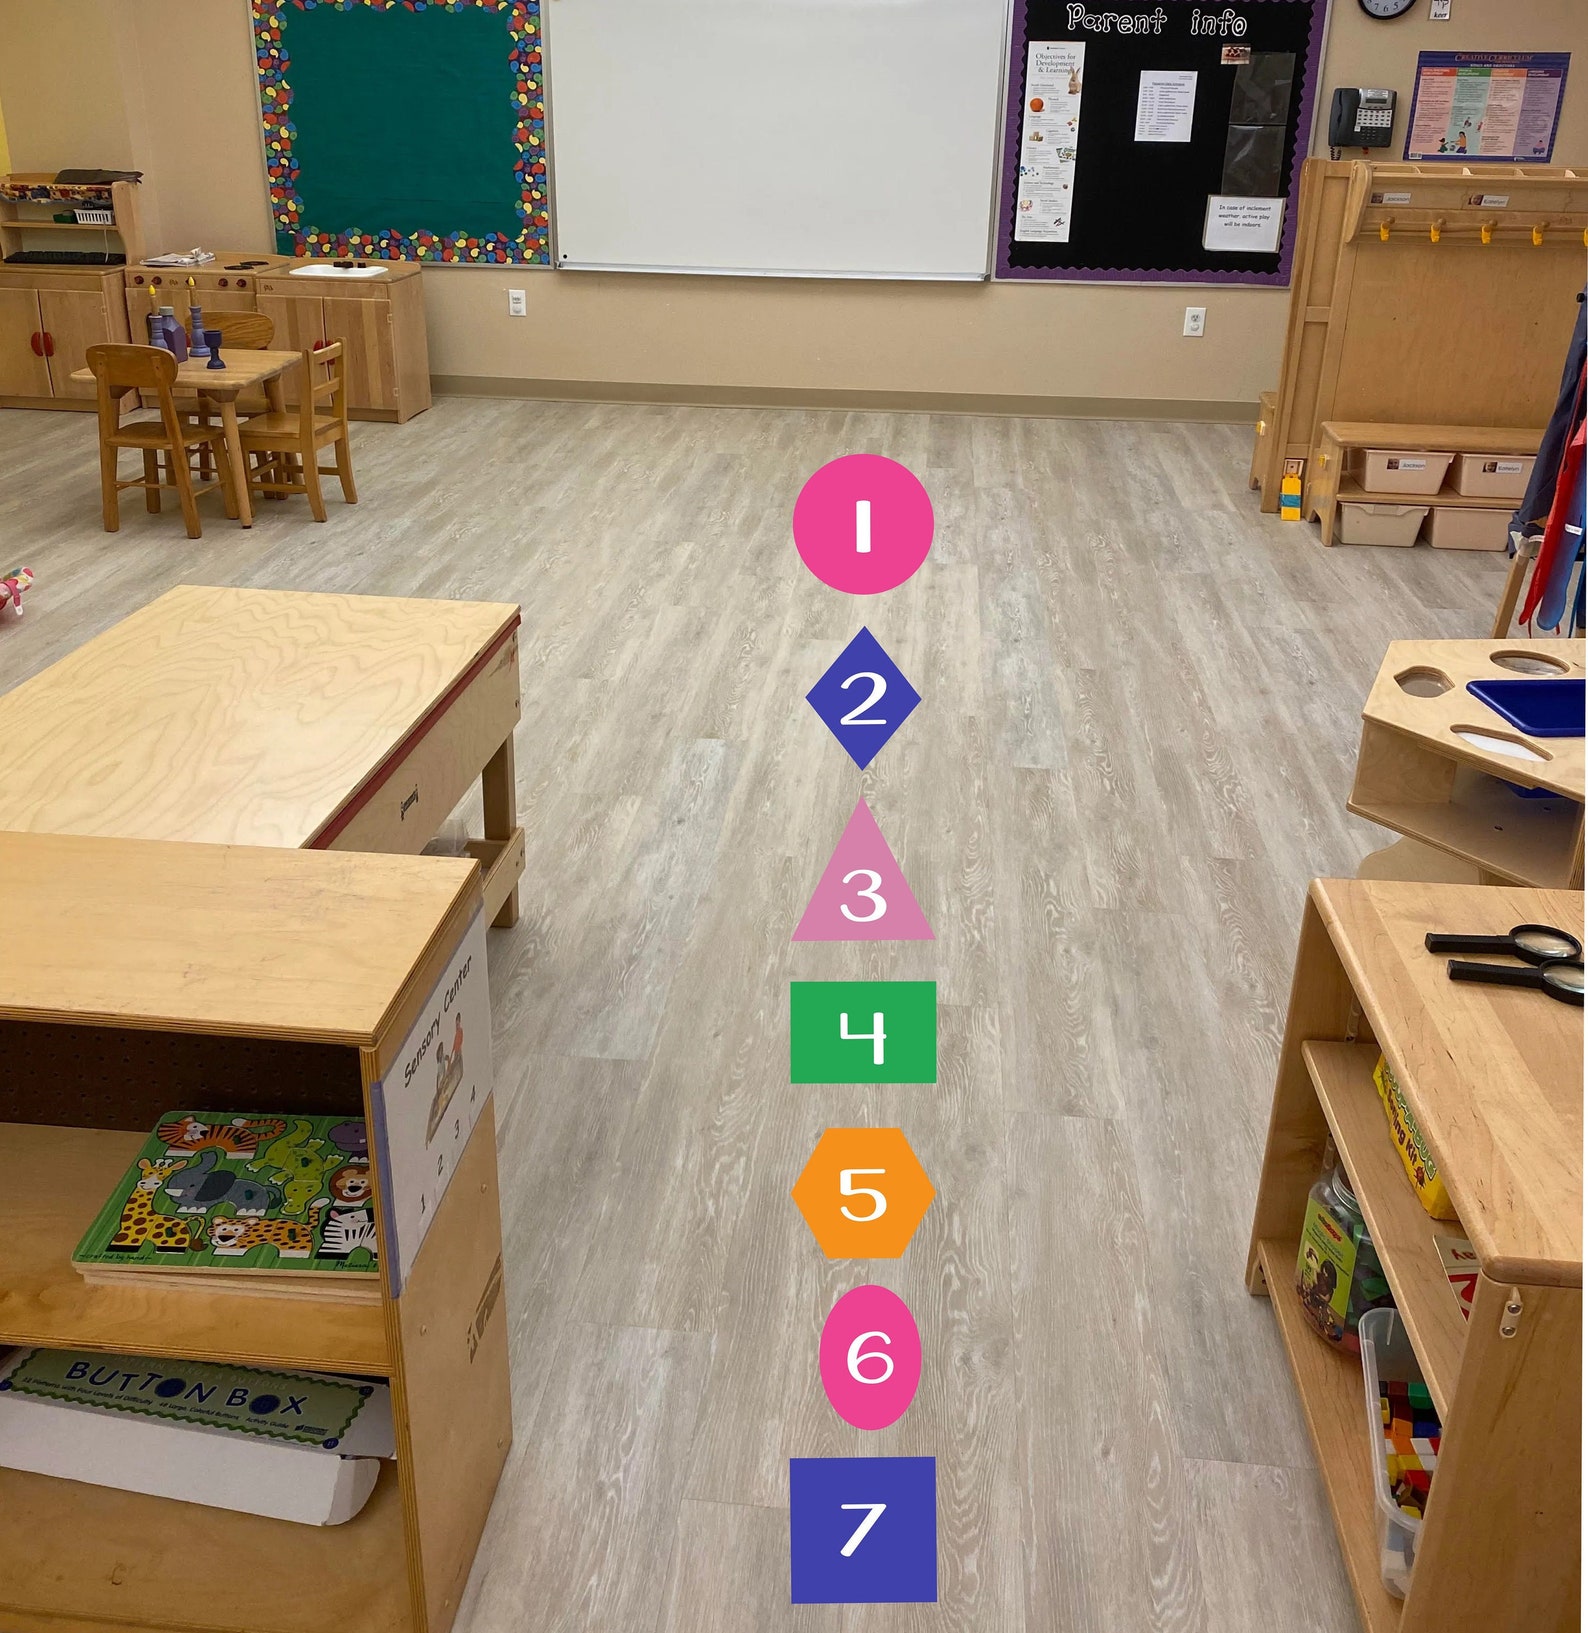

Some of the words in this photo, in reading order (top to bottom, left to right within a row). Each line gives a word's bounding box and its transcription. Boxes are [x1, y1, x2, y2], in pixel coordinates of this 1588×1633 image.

[1066, 3, 1168, 34] Parent
[1190, 9, 1248, 36] info
[1393, 2, 1399, 10] 5
[1035, 52, 1066, 61] Objectives
[1067, 52, 1076, 60] for
[1035, 59, 1075, 68] Development
[404, 1011, 441, 1088] Sensory
[443, 955, 472, 1013] Center
[421, 1193, 426, 1214] 1
[437, 1153, 443, 1177] 2
[454, 1118, 460, 1140] 3
[65, 1361, 218, 1403] BUTTON
[225, 1388, 308, 1415] BOX
[77, 1386, 93, 1394] Four
[93, 1390, 114, 1399] Levels
[123, 1395, 153, 1405] Difficulty
[190, 1406, 215, 1415] Colorful
[215, 1411, 240, 1420] Buttons
[246, 1416, 268, 1425] Activity
[269, 1421, 289, 1429] Guide
